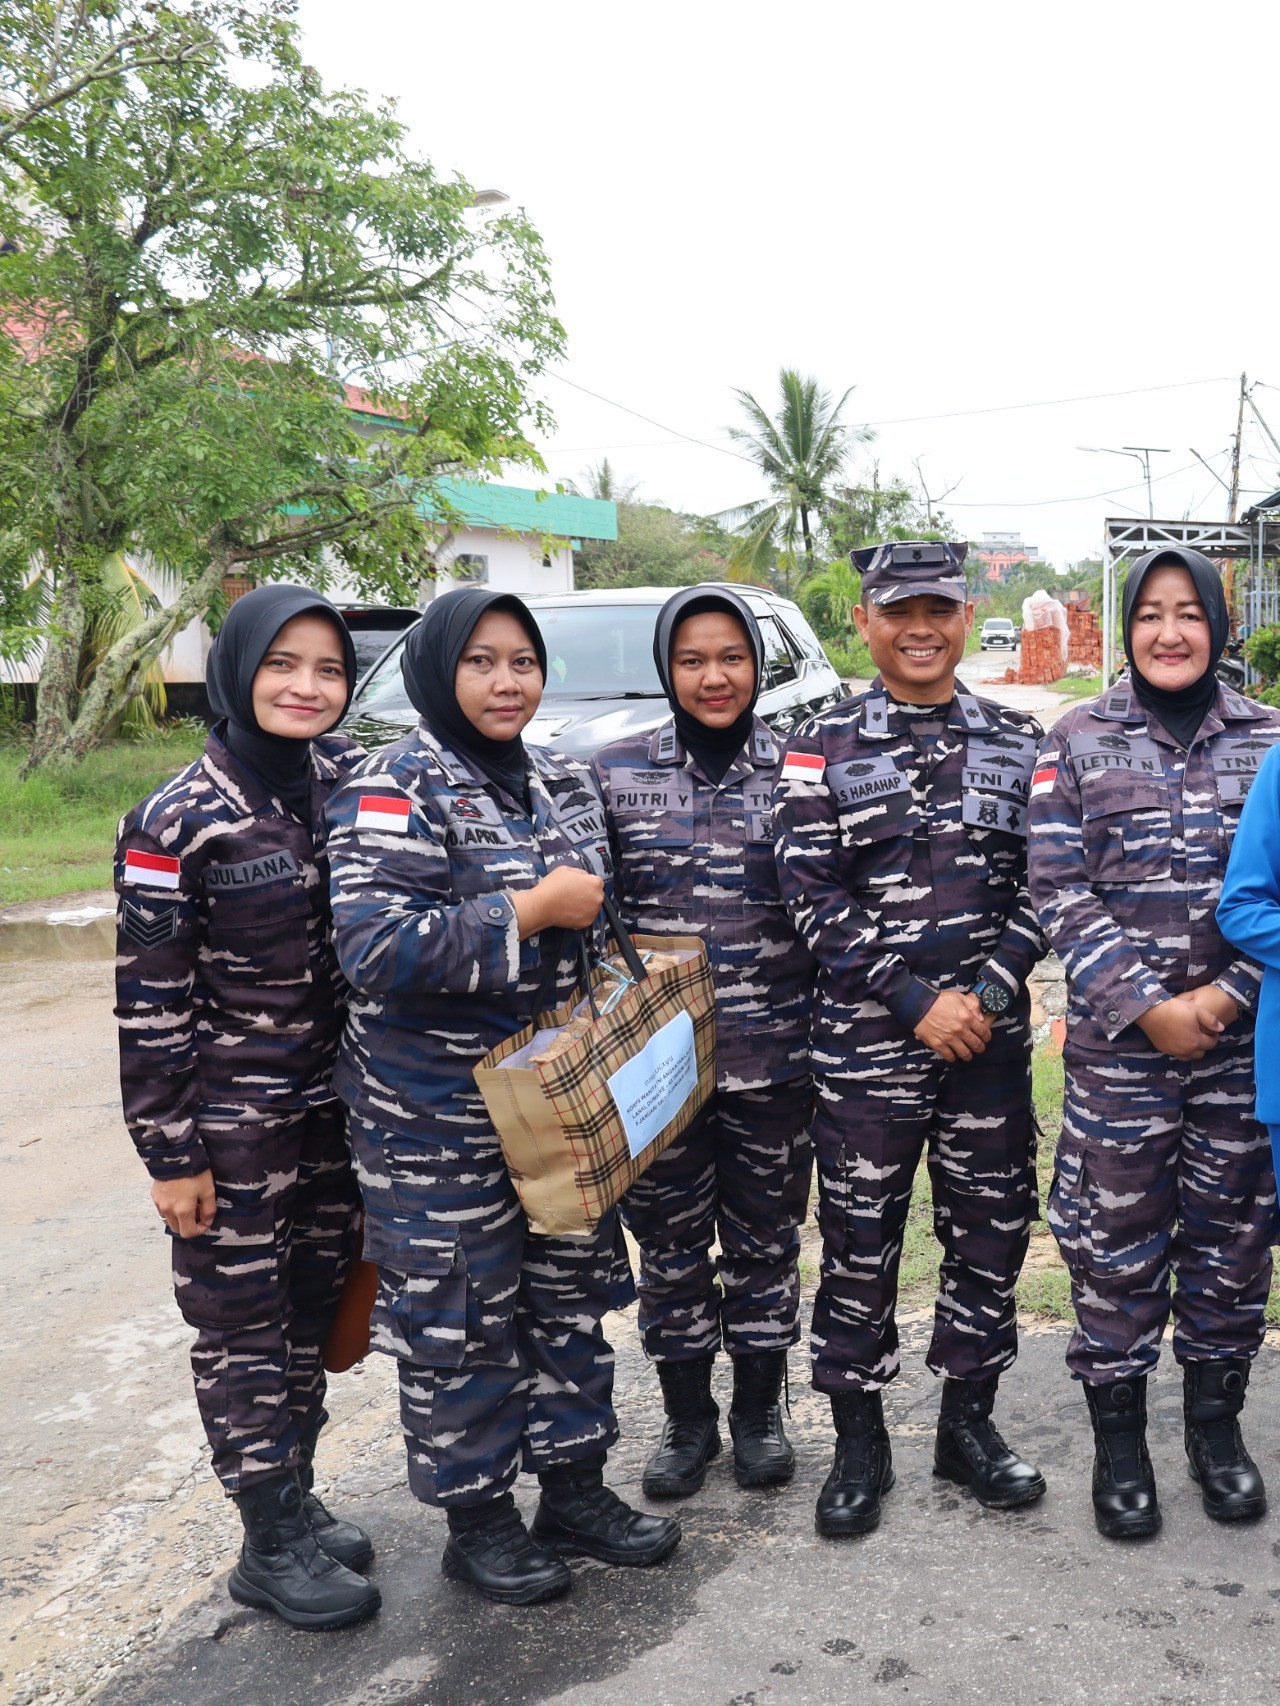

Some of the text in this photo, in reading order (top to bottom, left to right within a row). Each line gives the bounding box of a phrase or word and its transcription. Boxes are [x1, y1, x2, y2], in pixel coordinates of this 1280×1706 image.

[1081, 755, 1154, 771] LETTY N
[1221, 756, 1258, 769] TNI
[834, 777, 901, 804] A.S HARAHAP
[967, 771, 1028, 798] TNI AL
[617, 793, 688, 808] PUTRI Y
[750, 793, 771, 806] TN
[566, 816, 599, 836] TNI
[208, 855, 292, 886] JULIANA
